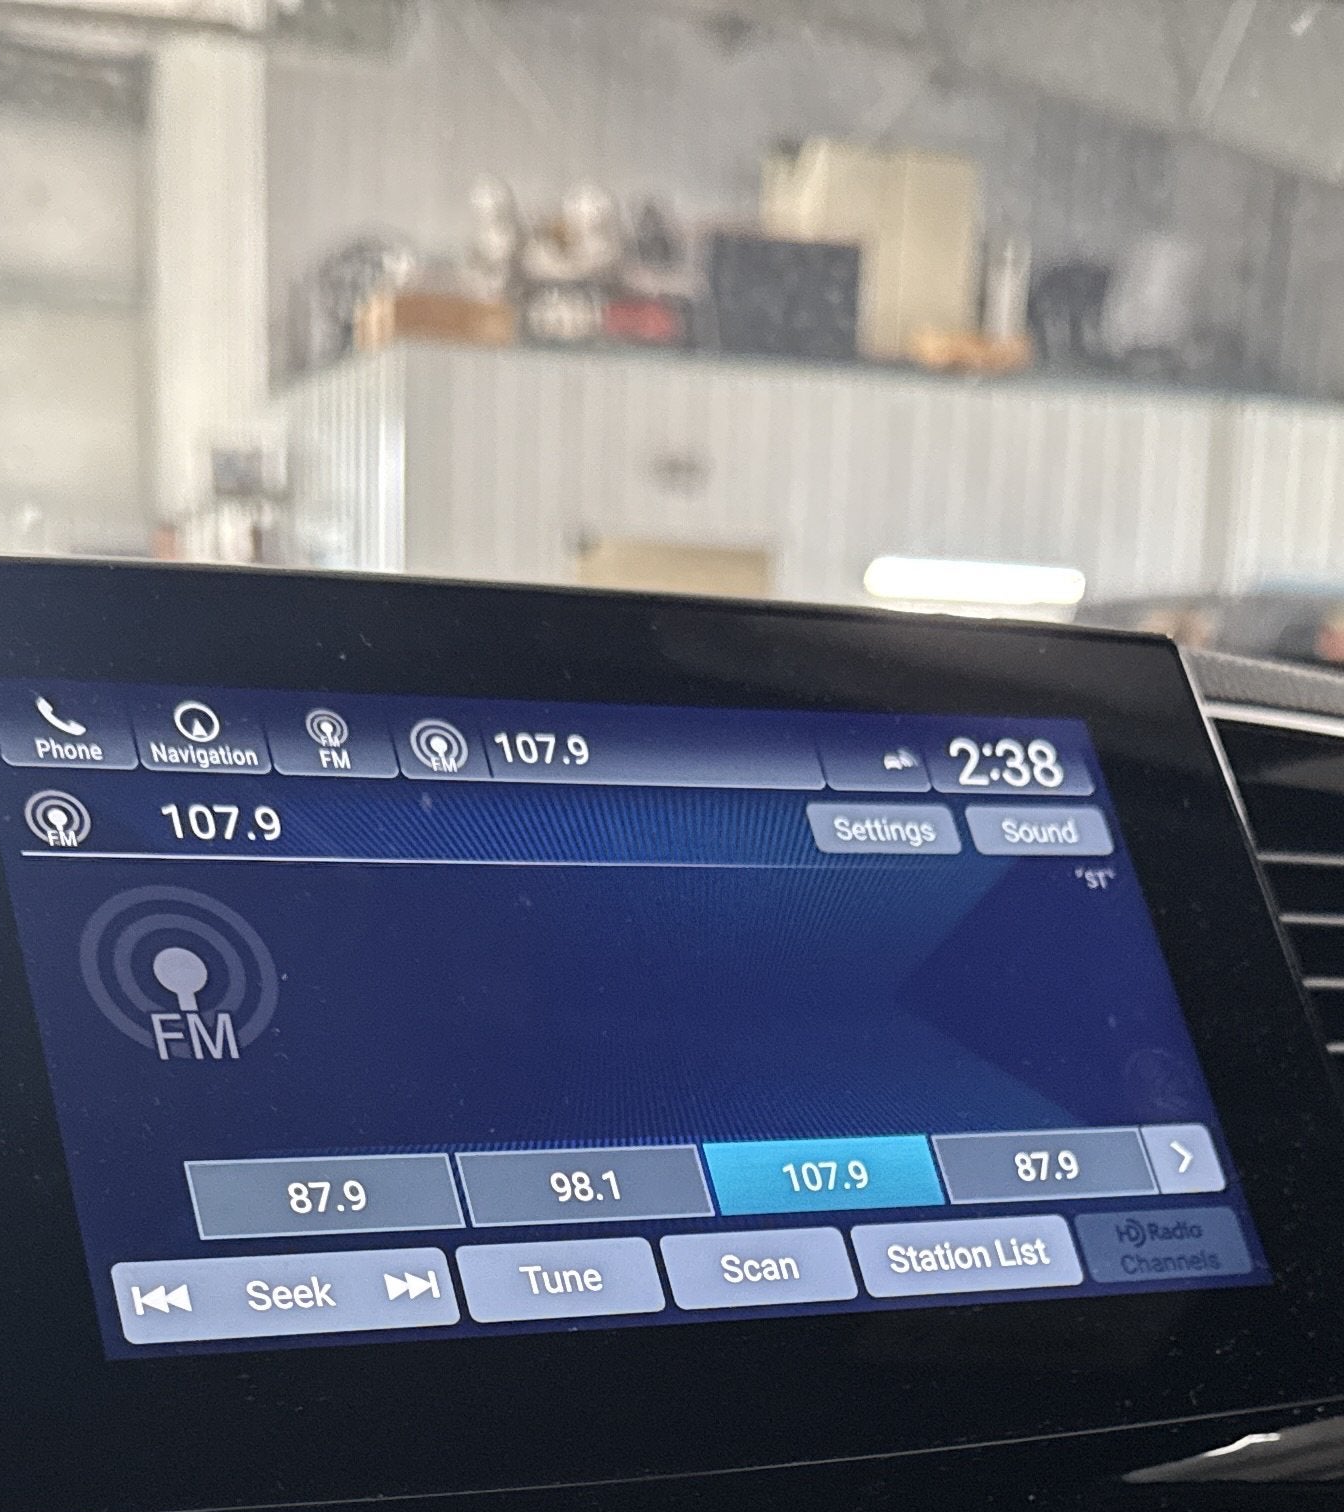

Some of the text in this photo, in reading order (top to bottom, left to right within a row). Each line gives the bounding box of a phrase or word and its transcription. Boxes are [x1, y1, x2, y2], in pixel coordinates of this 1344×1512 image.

[36, 738, 103, 762] Phone
[151, 743, 258, 770] Navigation
[319, 748, 351, 769] FM
[494, 732, 589, 765] 107.9
[949, 737, 1064, 788] 2:38
[431, 757, 458, 772] FM
[161, 803, 282, 841] 107.9
[834, 818, 936, 848] Settings
[1002, 819, 1078, 846] Sound
[47, 829, 78, 848] FM
[151, 1012, 240, 1060] FM
[782, 1161, 869, 1193] 107.9
[1014, 1151, 1079, 1182] 87.9
[287, 1180, 368, 1214] 87.9
[549, 1171, 622, 1202] 98.1
[1147, 1221, 1203, 1241] Radio
[721, 1254, 800, 1285] Scan
[887, 1238, 1050, 1275] Station List
[1120, 1250, 1221, 1275] Channels
[247, 1276, 336, 1312] Seek
[519, 1263, 603, 1295] Tune
